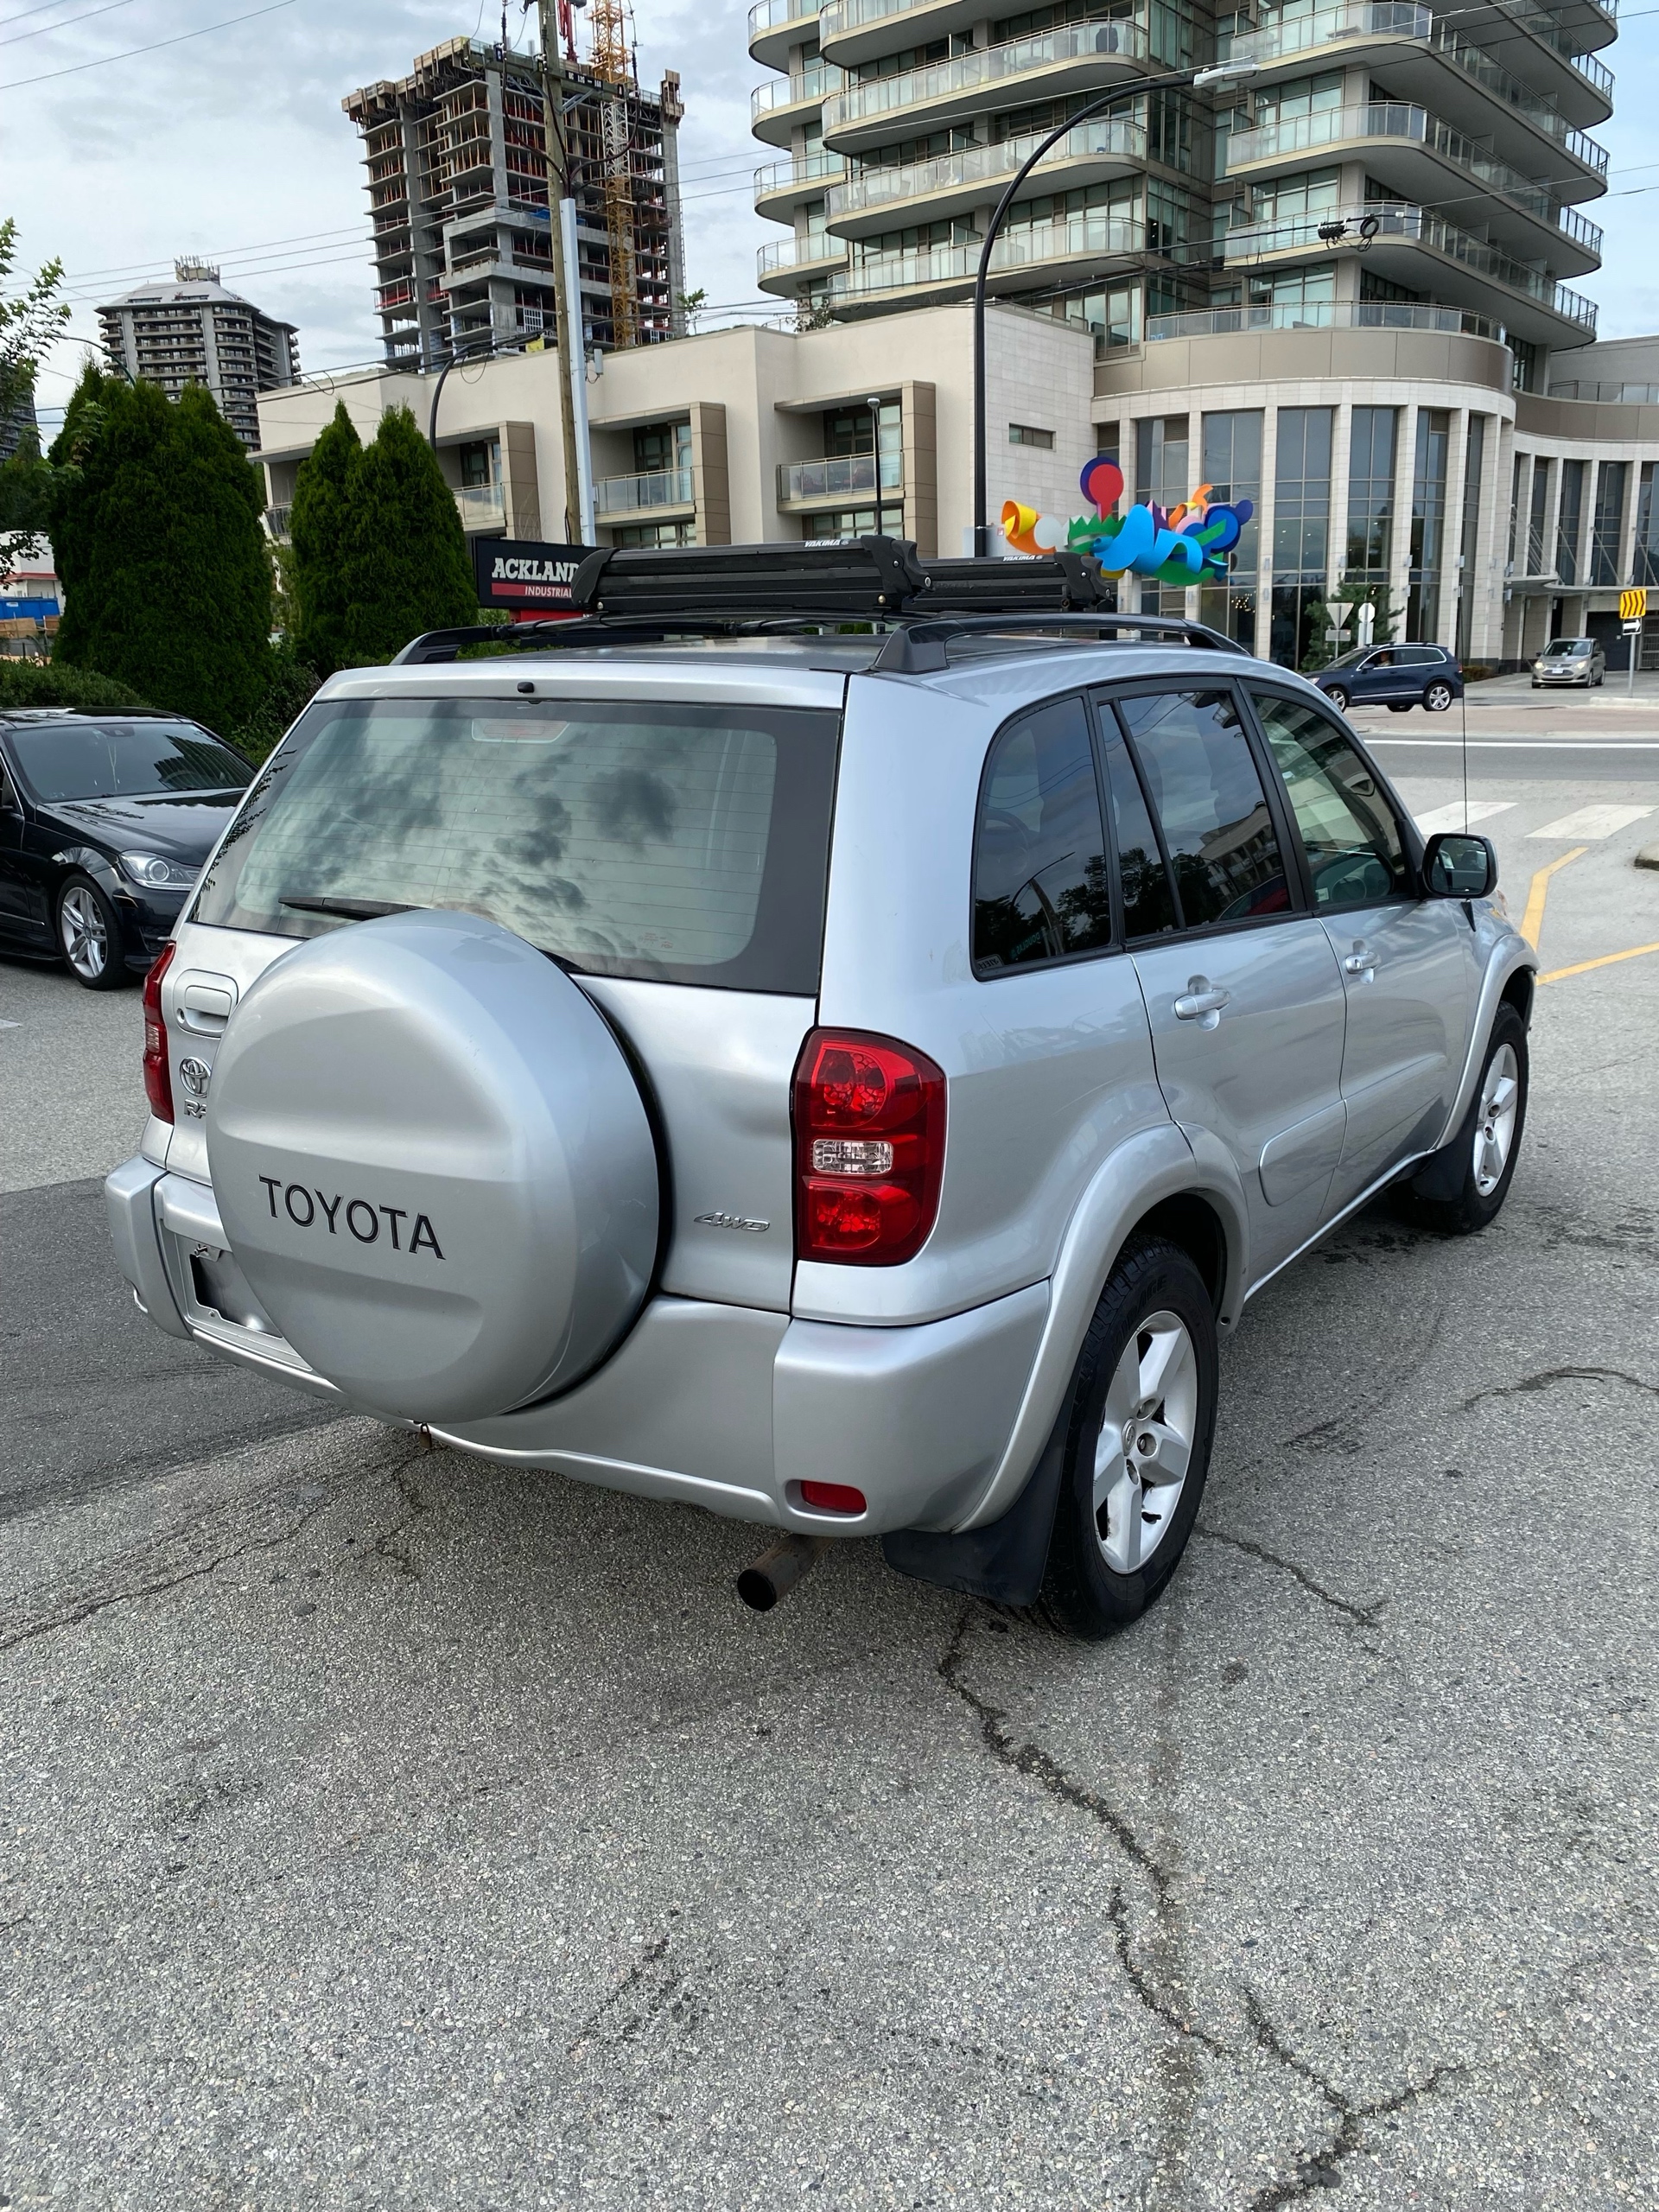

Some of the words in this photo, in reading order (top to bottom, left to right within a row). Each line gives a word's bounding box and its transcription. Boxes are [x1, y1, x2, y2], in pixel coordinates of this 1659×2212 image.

[804, 539, 841, 548] YAKIMA
[257, 1174, 447, 1261] TOYOTA
[693, 1211, 771, 1232] 4WD
[1111, 1274, 1167, 1360] MIRAGE
